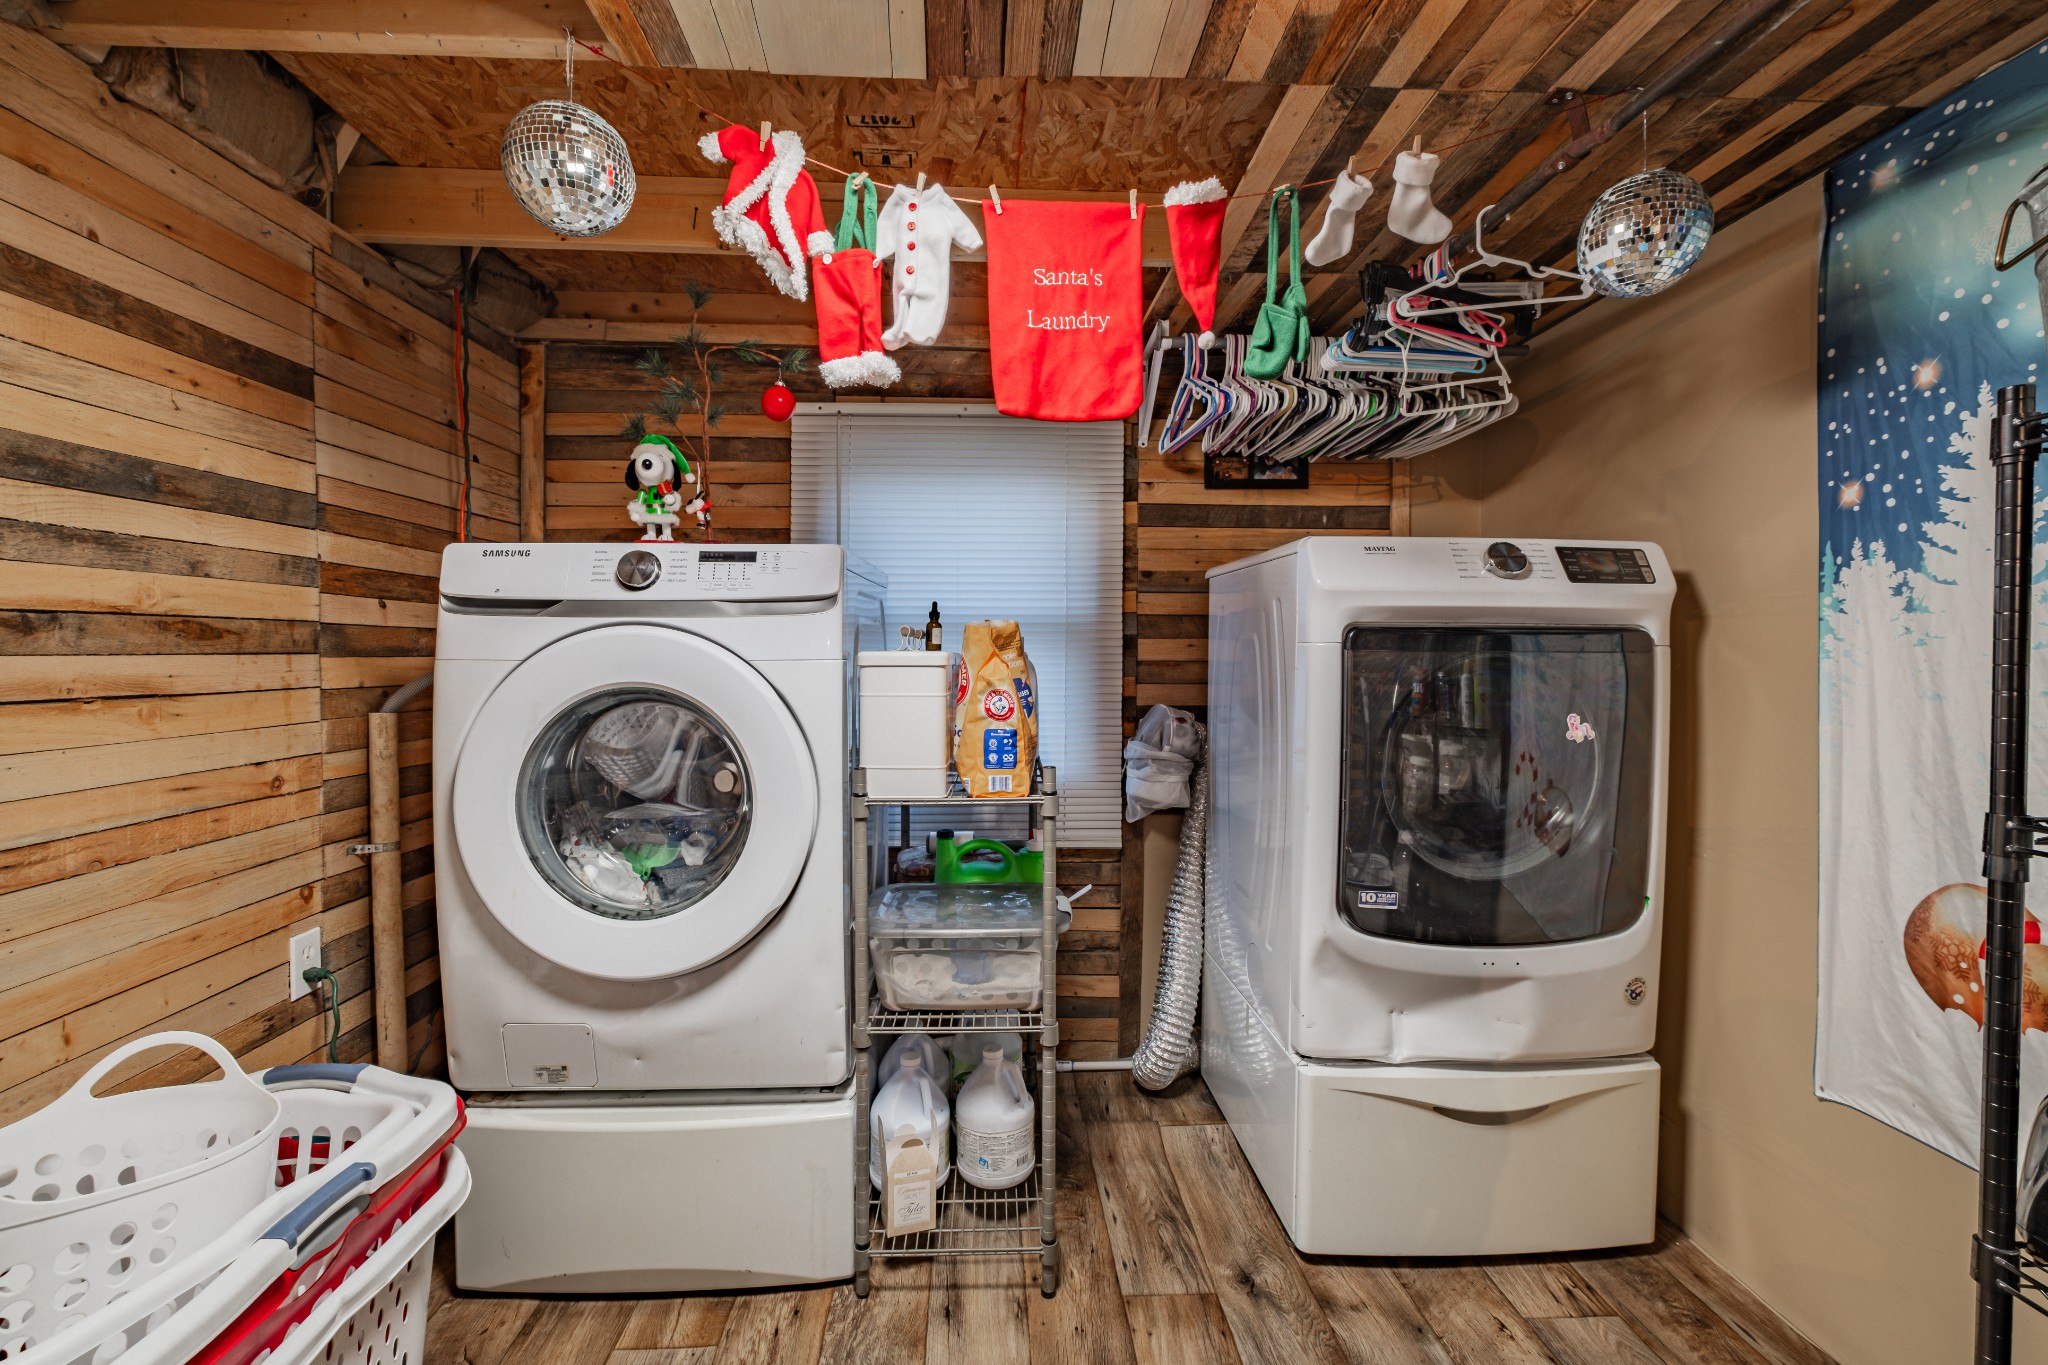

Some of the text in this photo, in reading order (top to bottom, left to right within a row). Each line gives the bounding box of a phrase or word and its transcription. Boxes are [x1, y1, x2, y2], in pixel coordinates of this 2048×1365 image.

[1033, 268, 1103, 286] Santa's
[1027, 309, 1111, 332] Laundry
[482, 549, 531, 557] SAMSUNG
[1361, 893, 1376, 902] 10
